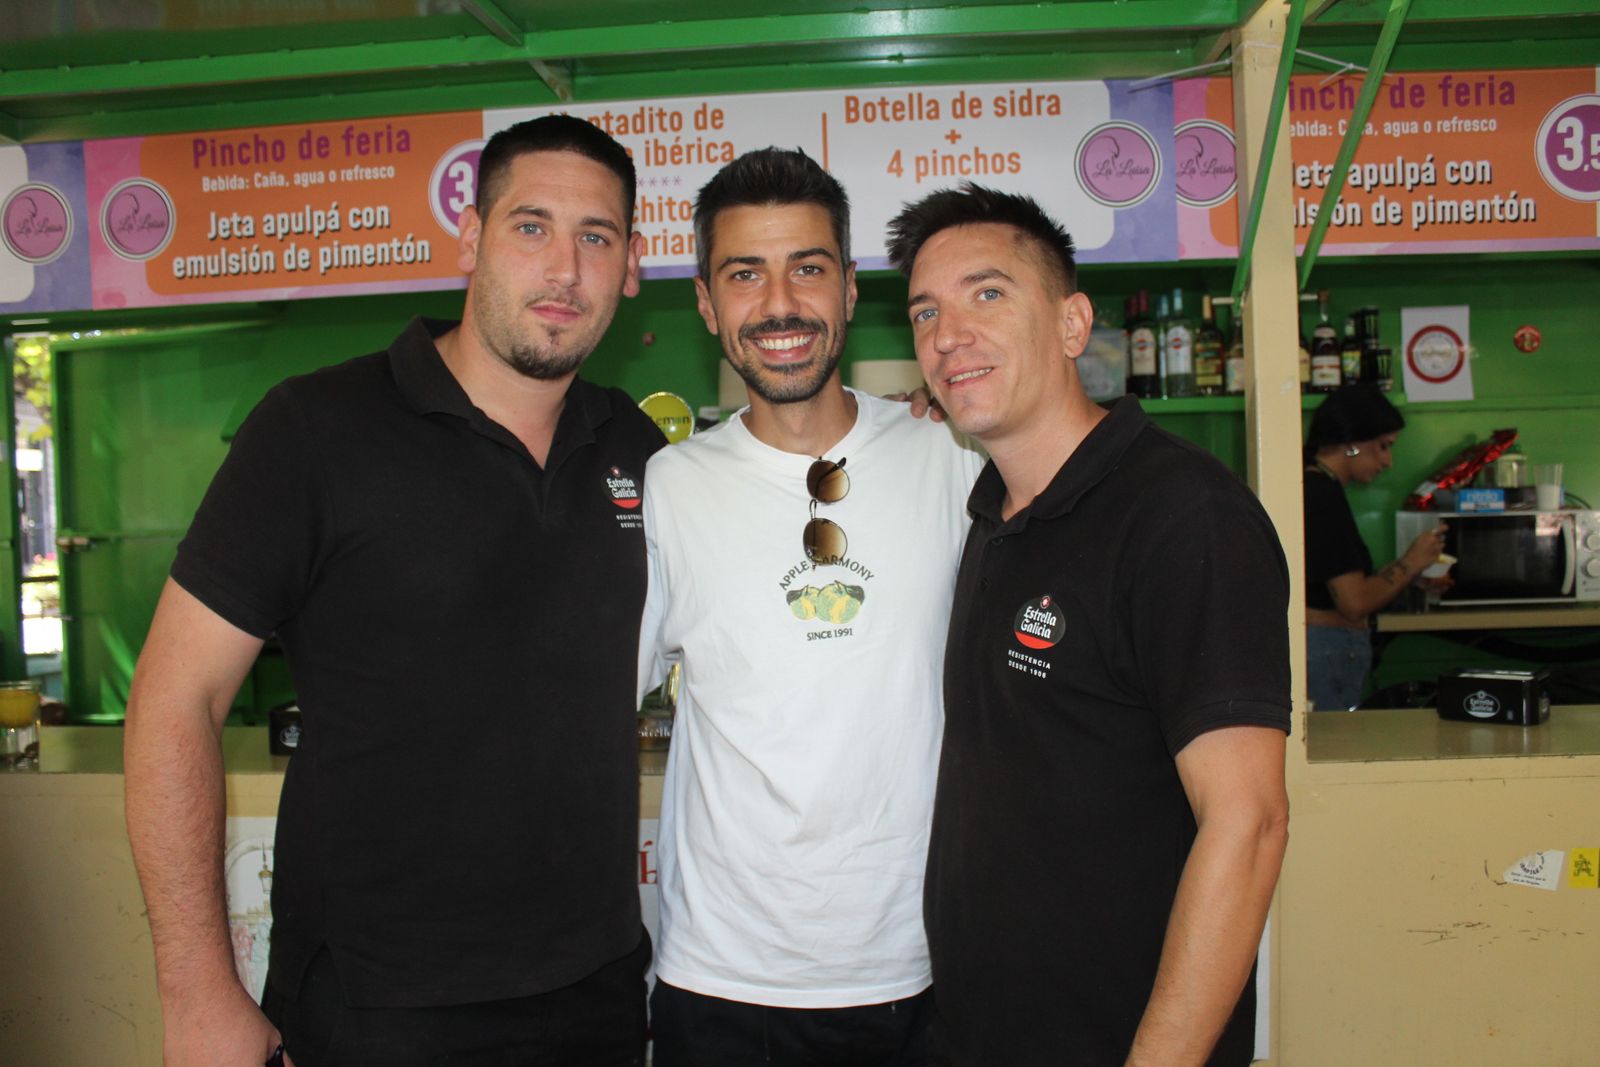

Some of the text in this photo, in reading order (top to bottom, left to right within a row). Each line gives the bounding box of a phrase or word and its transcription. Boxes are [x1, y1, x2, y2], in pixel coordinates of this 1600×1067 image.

[844, 88, 1062, 124] Botella de sidra
[1289, 75, 1516, 112] inch de feria
[694, 102, 725, 131] de
[1384, 120, 1419, 137] agua
[1424, 122, 1432, 133] o
[1436, 115, 1497, 132] refresco
[192, 123, 412, 169] Pincho de feria
[645, 136, 735, 167] ibérica
[202, 163, 396, 192] Bebida: Caña, agua o refresco
[887, 146, 1022, 183] 4 pinchos
[1347, 154, 1436, 192] apulpá
[1445, 159, 1492, 185] con
[207, 202, 391, 240] Jeta apulpá con
[1371, 194, 1404, 225] de
[1411, 190, 1537, 231] pimentón
[172, 233, 431, 280] emulsión de pimentón
[606, 477, 635, 488] Estrella
[611, 487, 638, 499] Galicia
[779, 560, 810, 591] APPLE
[1020, 618, 1052, 639] Galicia
[1023, 605, 1057, 627] Estrella
[806, 627, 853, 641] SINCE 1991
[1008, 649, 1051, 670] RESISTENCIA
[1008, 659, 1028, 673] DESDE
